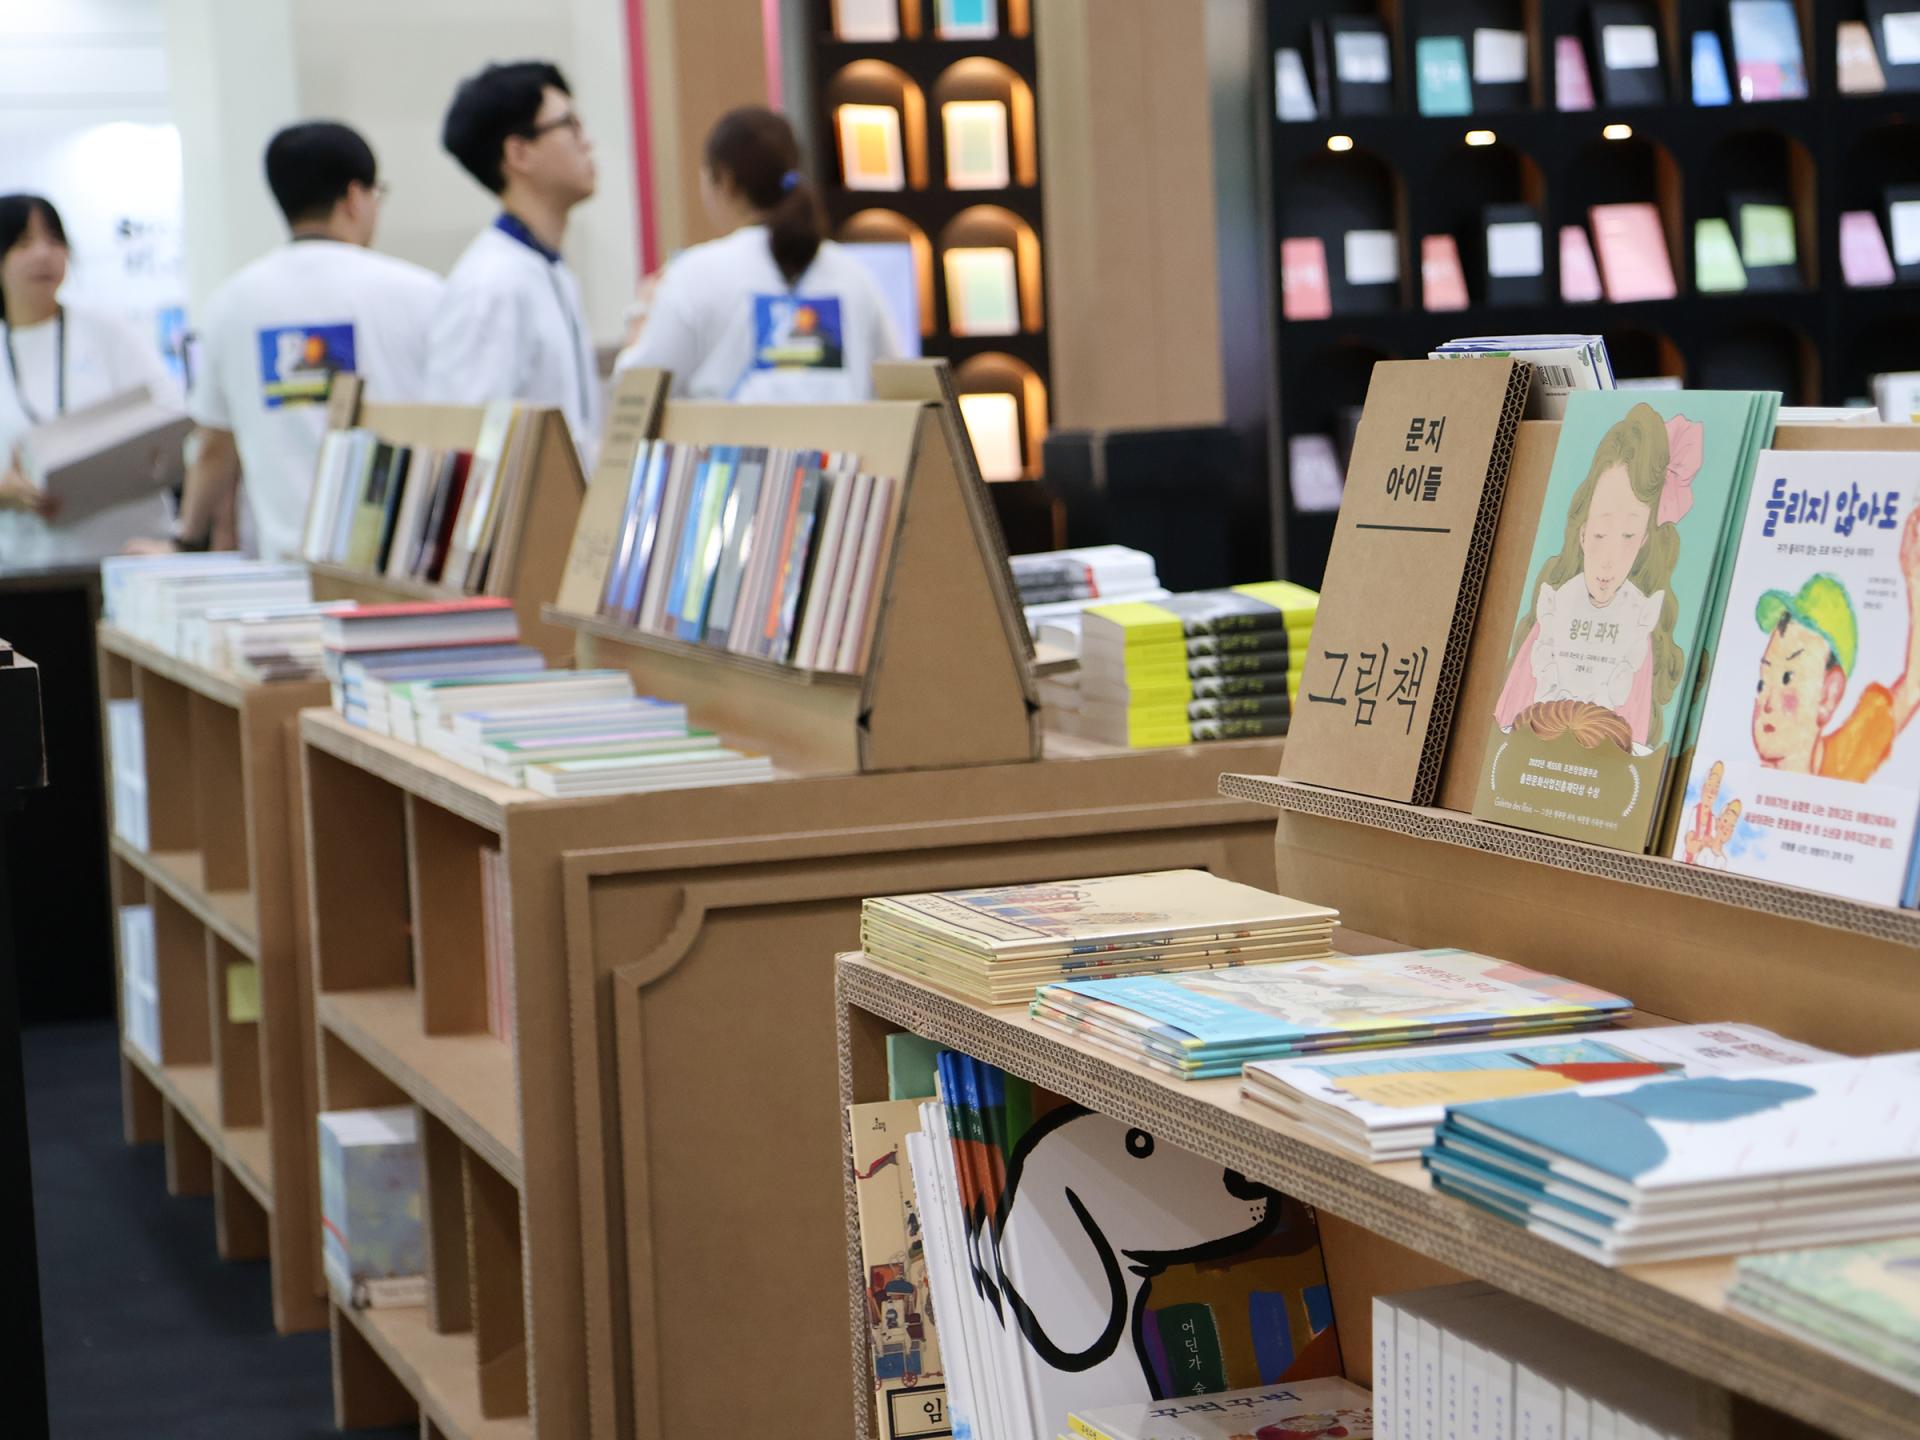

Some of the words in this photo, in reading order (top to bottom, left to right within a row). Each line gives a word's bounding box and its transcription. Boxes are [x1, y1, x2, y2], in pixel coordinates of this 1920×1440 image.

[1405, 416, 1446, 453] 문지
[1386, 464, 1443, 502] 아이들
[1762, 478, 1830, 537] 들리지
[1834, 481, 1900, 537] 않아도
[1570, 618, 1592, 641] 왕의
[1594, 621, 1620, 645] 과자
[1308, 642, 1429, 735] 그림책
[1586, 784, 1601, 799] 수상
[1181, 1318, 1202, 1371] 어딘가
